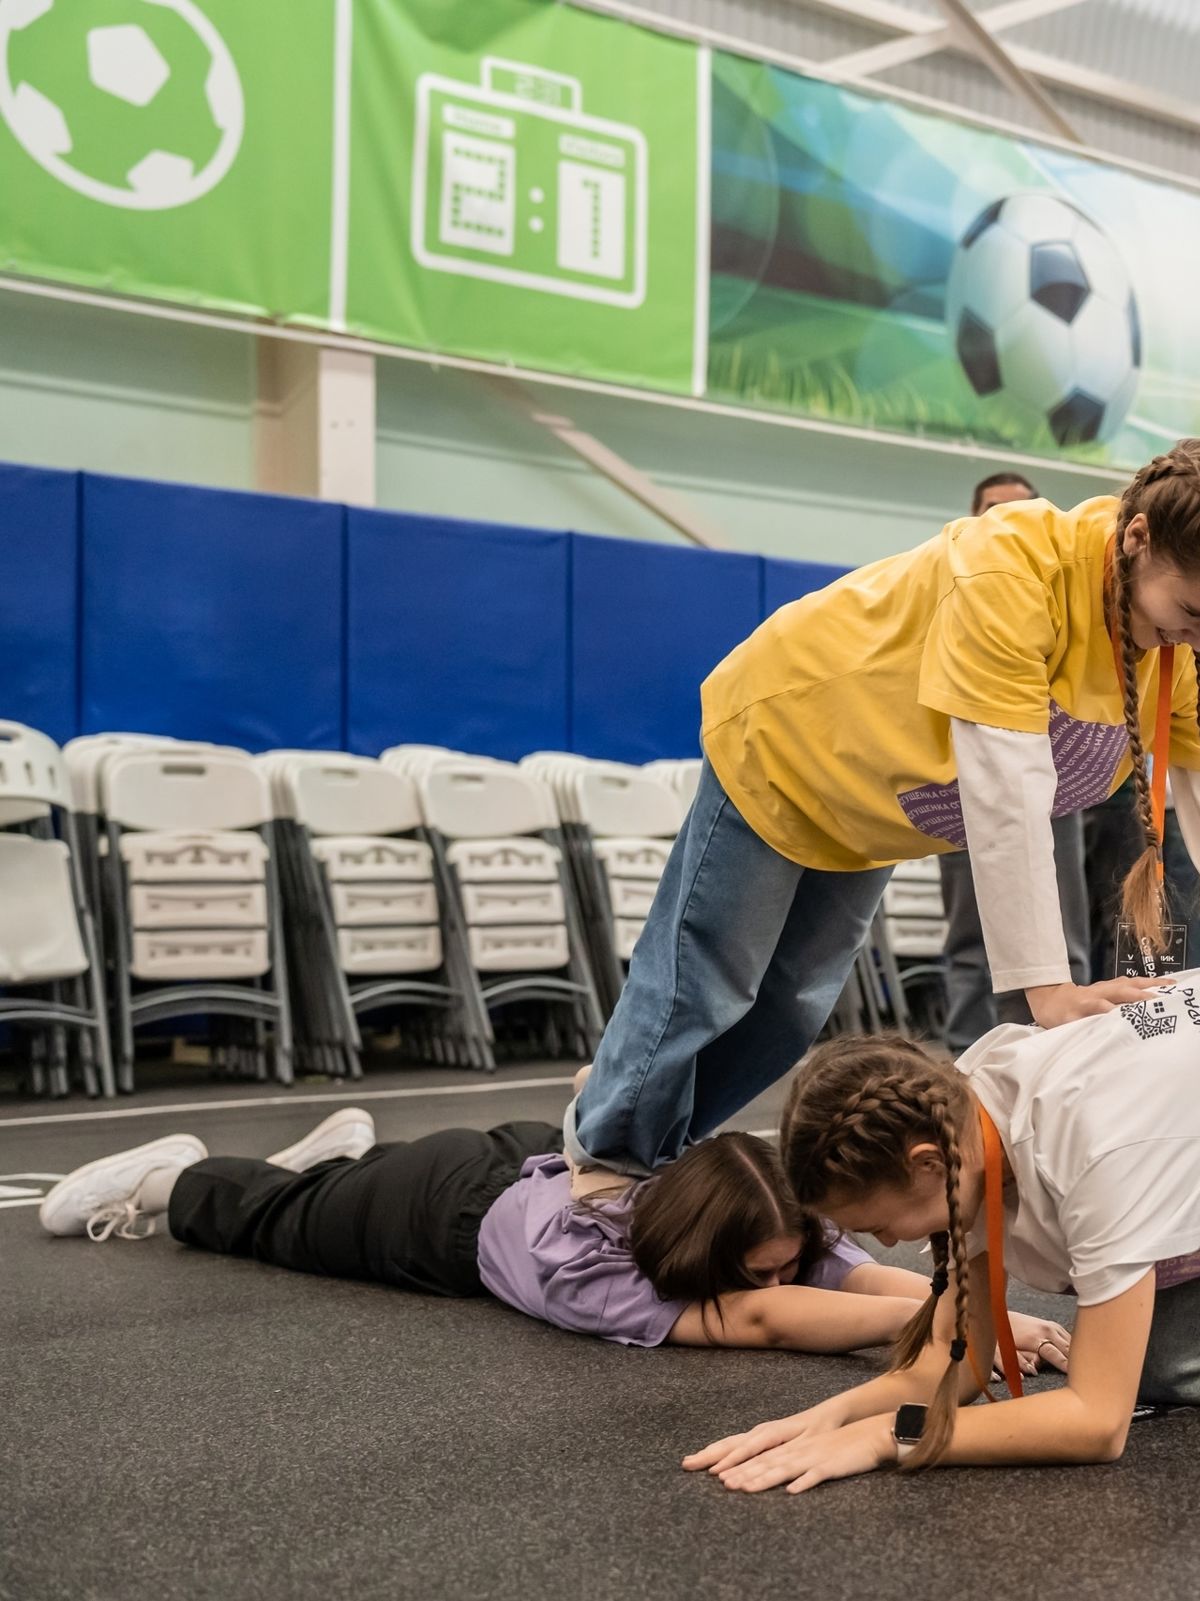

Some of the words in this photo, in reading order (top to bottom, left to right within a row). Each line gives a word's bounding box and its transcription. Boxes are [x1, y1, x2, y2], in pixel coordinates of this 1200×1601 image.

[1055, 722, 1088, 763] СГУЩЕНКА
[1067, 723, 1097, 766] СГУЩЕНКА
[908, 804, 950, 820] СГУЩЕНКА
